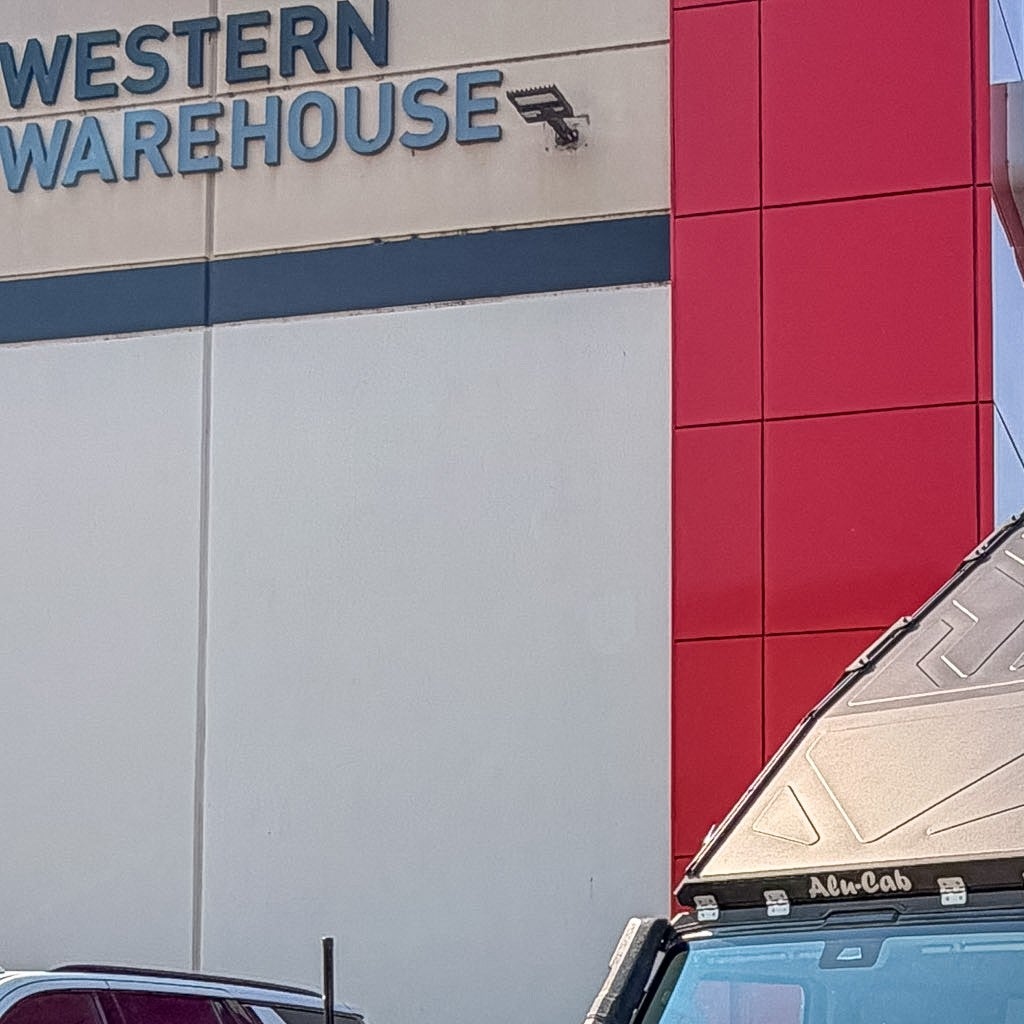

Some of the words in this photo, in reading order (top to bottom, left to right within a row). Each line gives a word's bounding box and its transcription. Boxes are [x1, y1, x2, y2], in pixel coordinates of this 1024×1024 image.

[0, 0, 390, 109] WESTERN
[0, 69, 504, 193] WAREHOUSE
[808, 869, 912, 899] Alu-Cab
